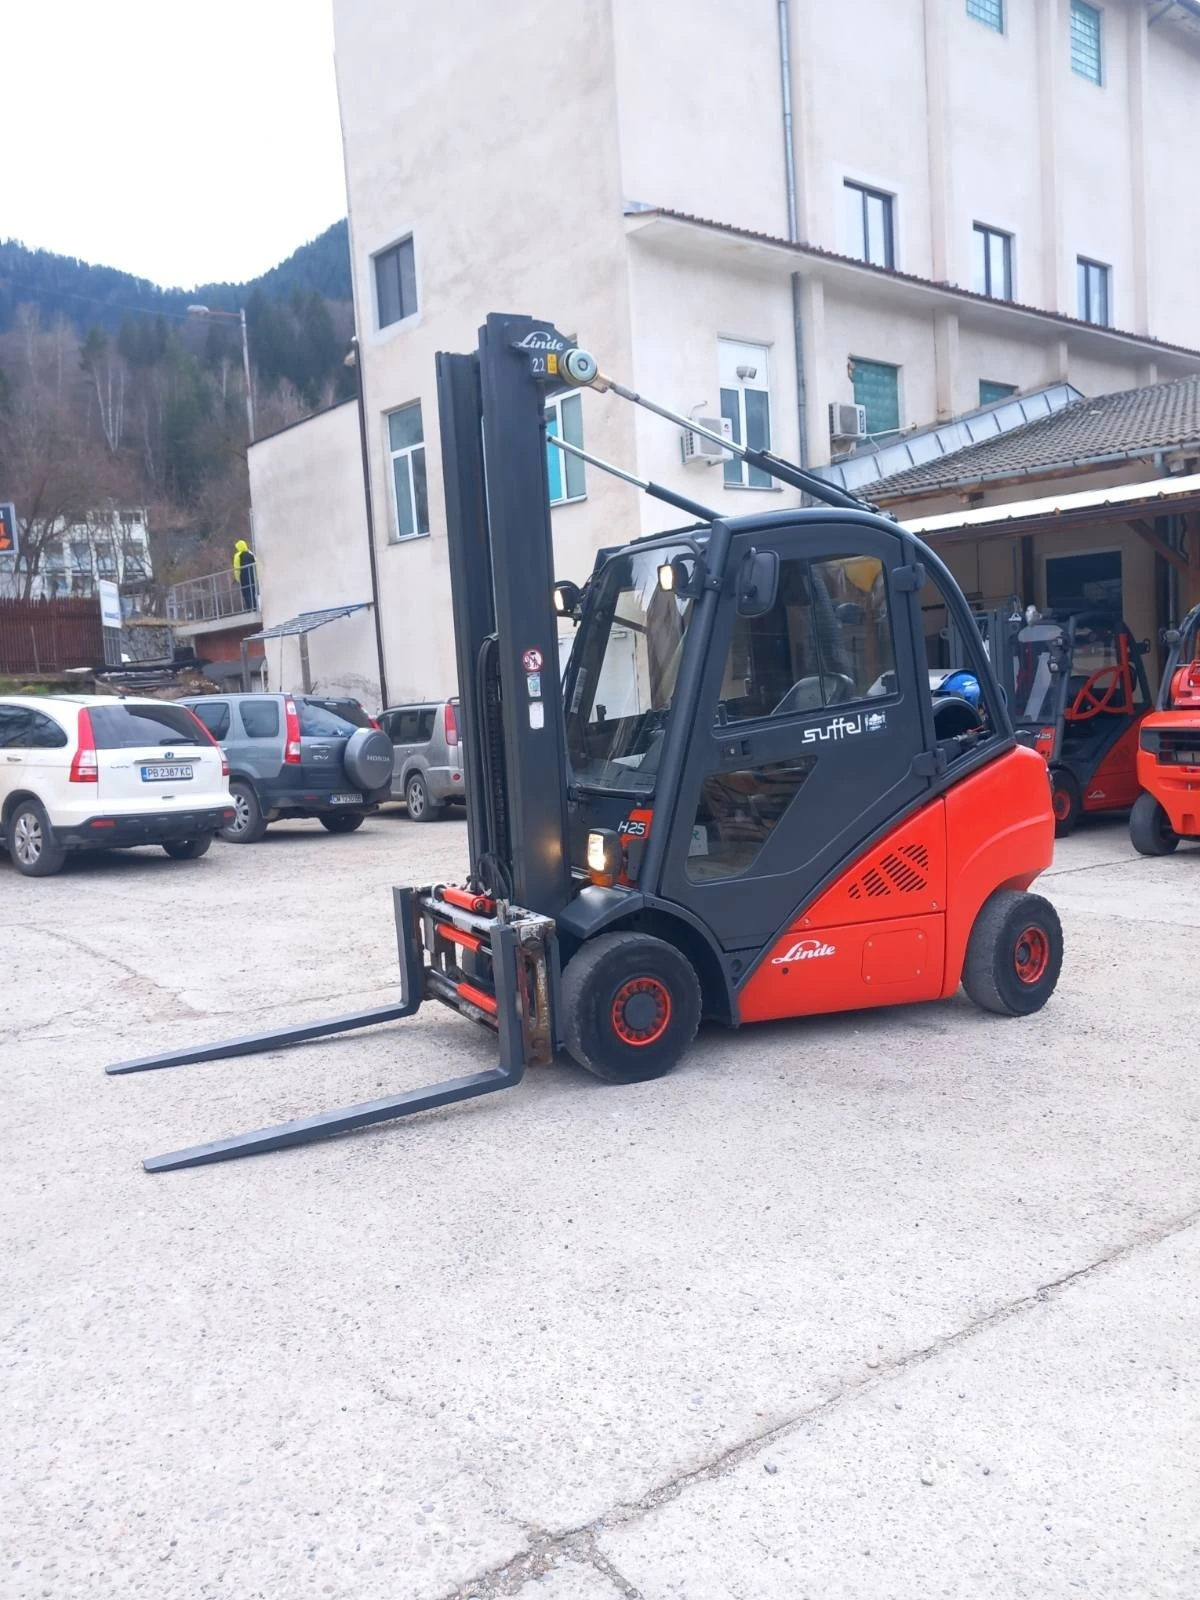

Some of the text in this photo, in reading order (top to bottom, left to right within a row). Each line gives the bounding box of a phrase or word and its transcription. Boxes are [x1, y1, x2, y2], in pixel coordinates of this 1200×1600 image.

[512, 331, 563, 350] Linde
[801, 714, 862, 744] suffel
[618, 821, 647, 835] H25
[771, 939, 836, 964] Linde
